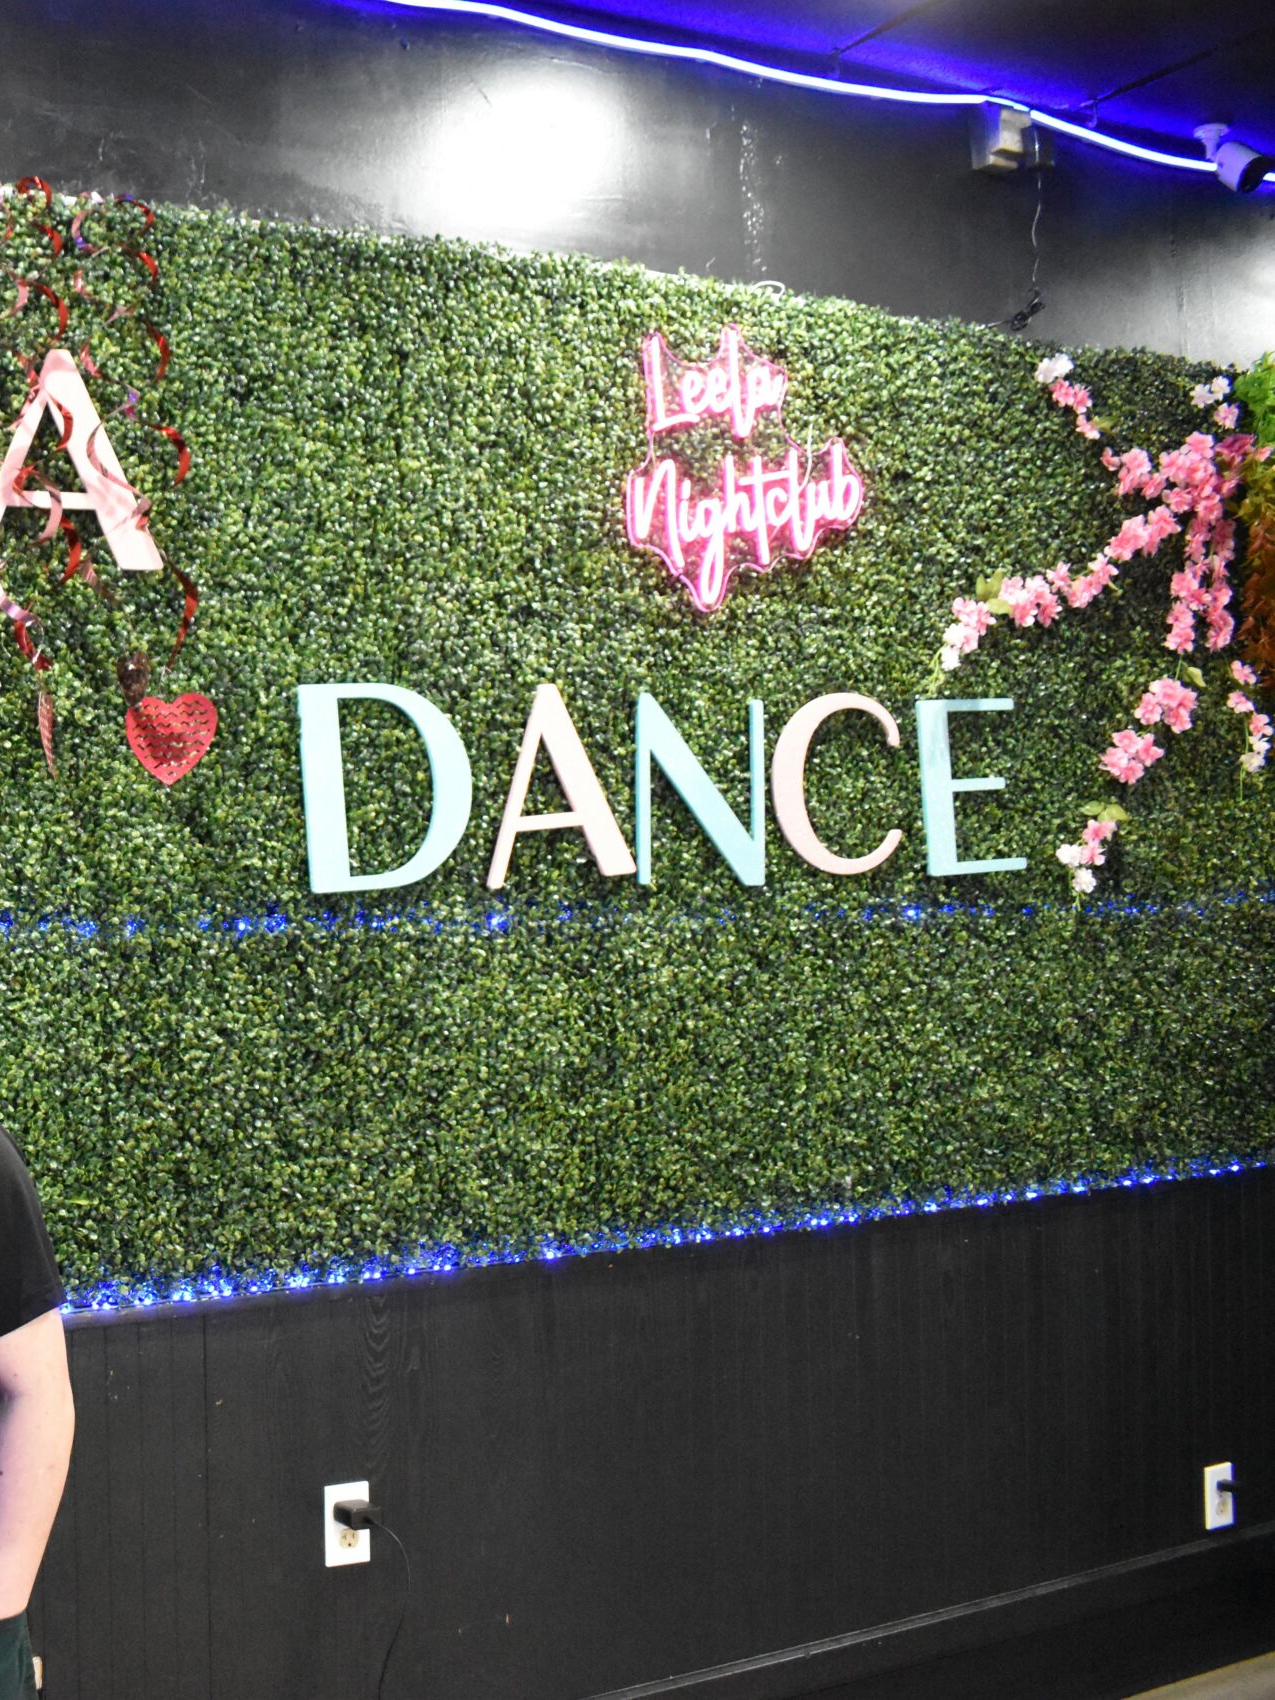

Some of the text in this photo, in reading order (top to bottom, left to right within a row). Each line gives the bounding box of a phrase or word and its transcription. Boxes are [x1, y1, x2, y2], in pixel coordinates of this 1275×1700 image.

[649, 329, 785, 438] Leela
[633, 442, 863, 605] Nightclub
[297, 683, 1027, 893] DANCE
